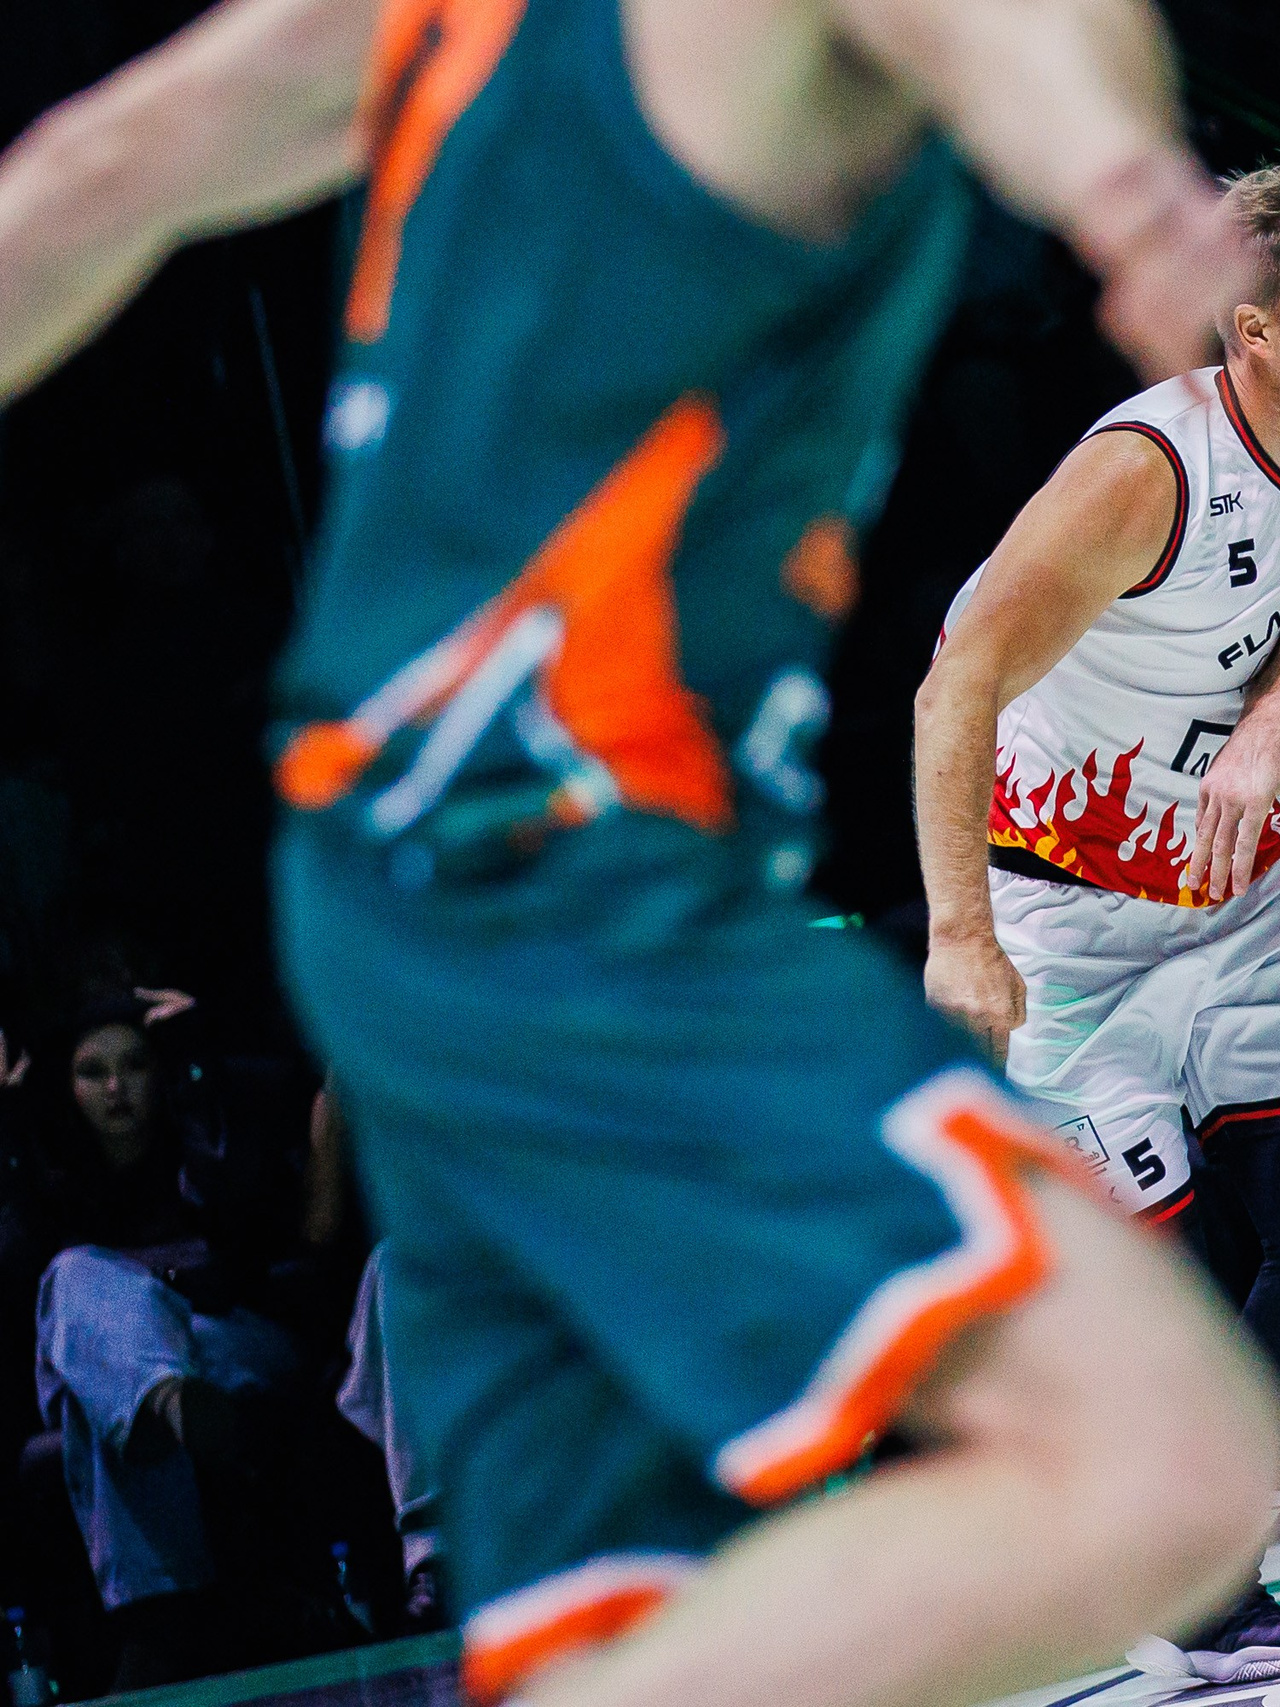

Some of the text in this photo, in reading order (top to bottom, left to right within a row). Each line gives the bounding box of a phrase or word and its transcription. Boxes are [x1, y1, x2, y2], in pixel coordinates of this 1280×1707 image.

[1210, 491, 1244, 517] STK
[1228, 538, 1257, 588] 5
[1121, 1137, 1166, 1191] 5
